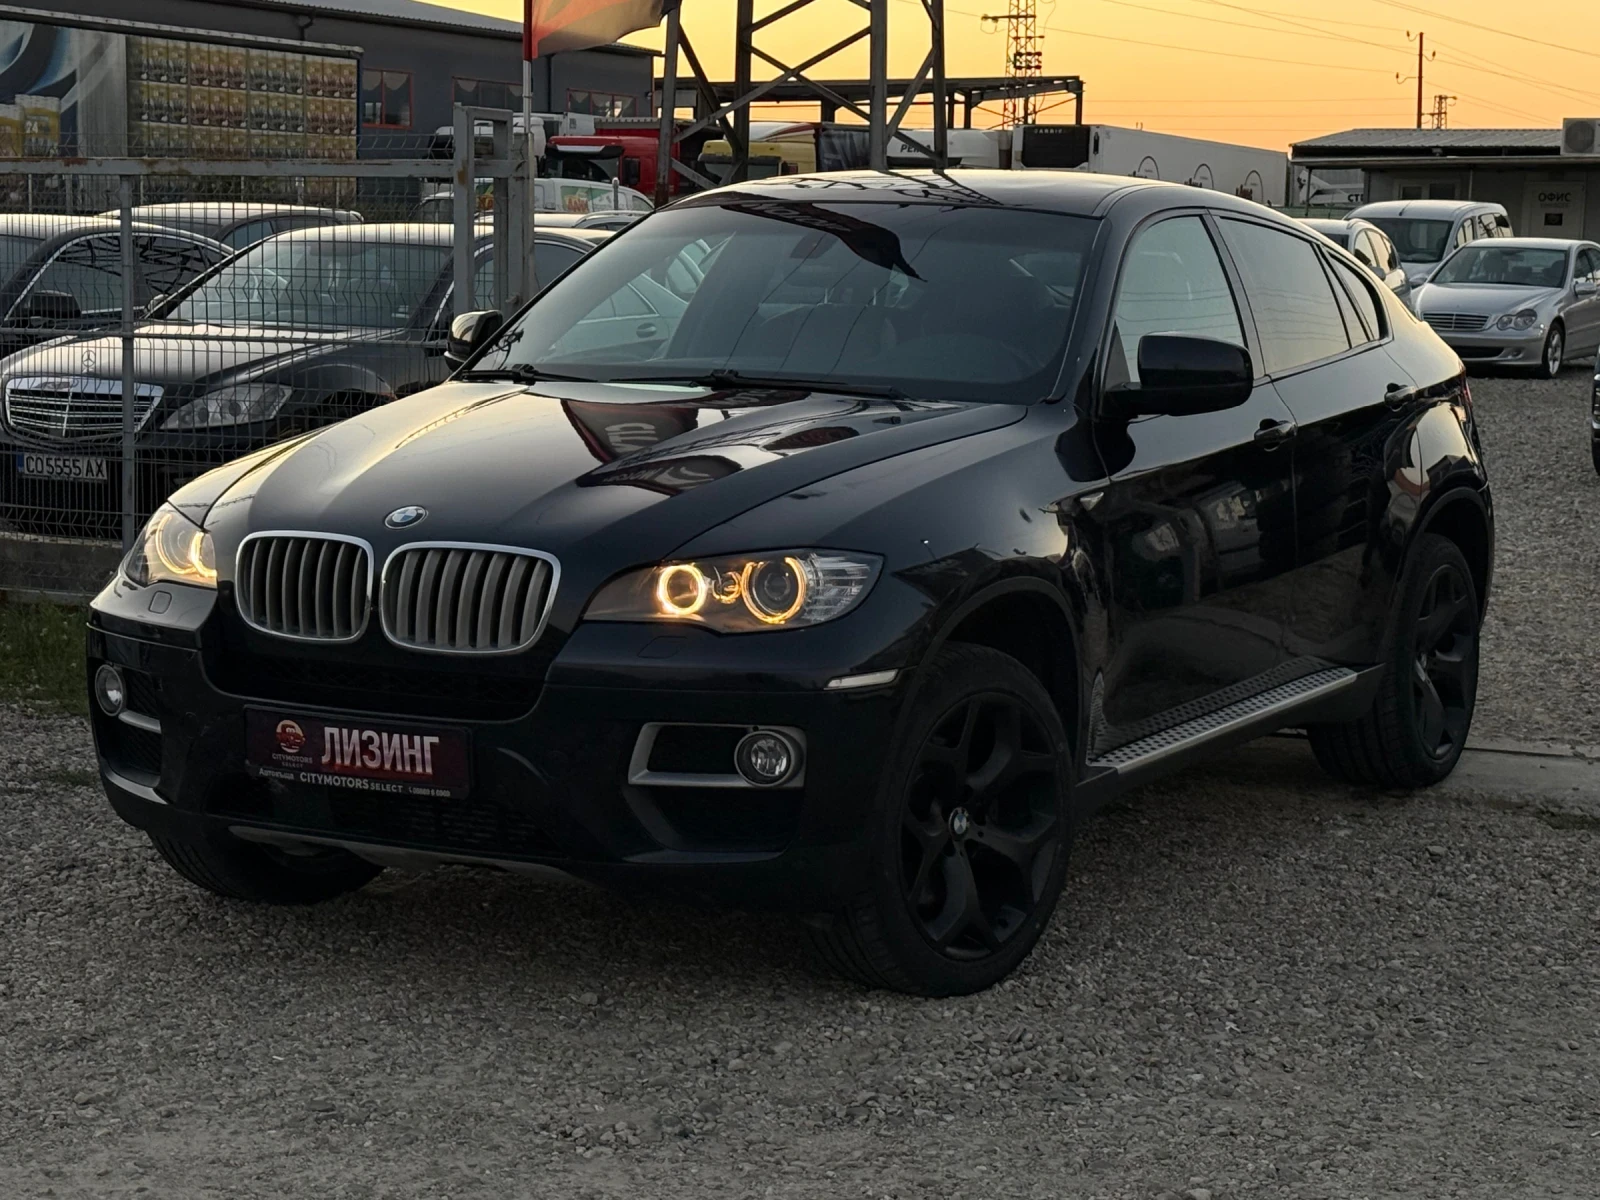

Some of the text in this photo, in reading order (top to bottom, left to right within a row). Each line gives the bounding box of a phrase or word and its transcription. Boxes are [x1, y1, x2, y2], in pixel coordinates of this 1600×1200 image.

[25, 120, 39, 134] 24
[1538, 192, 1572, 202] ОФИС
[321, 726, 440, 775] ЛИЗИНГ
[271, 752, 313, 764] CITYMOTORS
[299, 771, 370, 790] CITYMOTORS
[370, 782, 403, 793] SELECT
